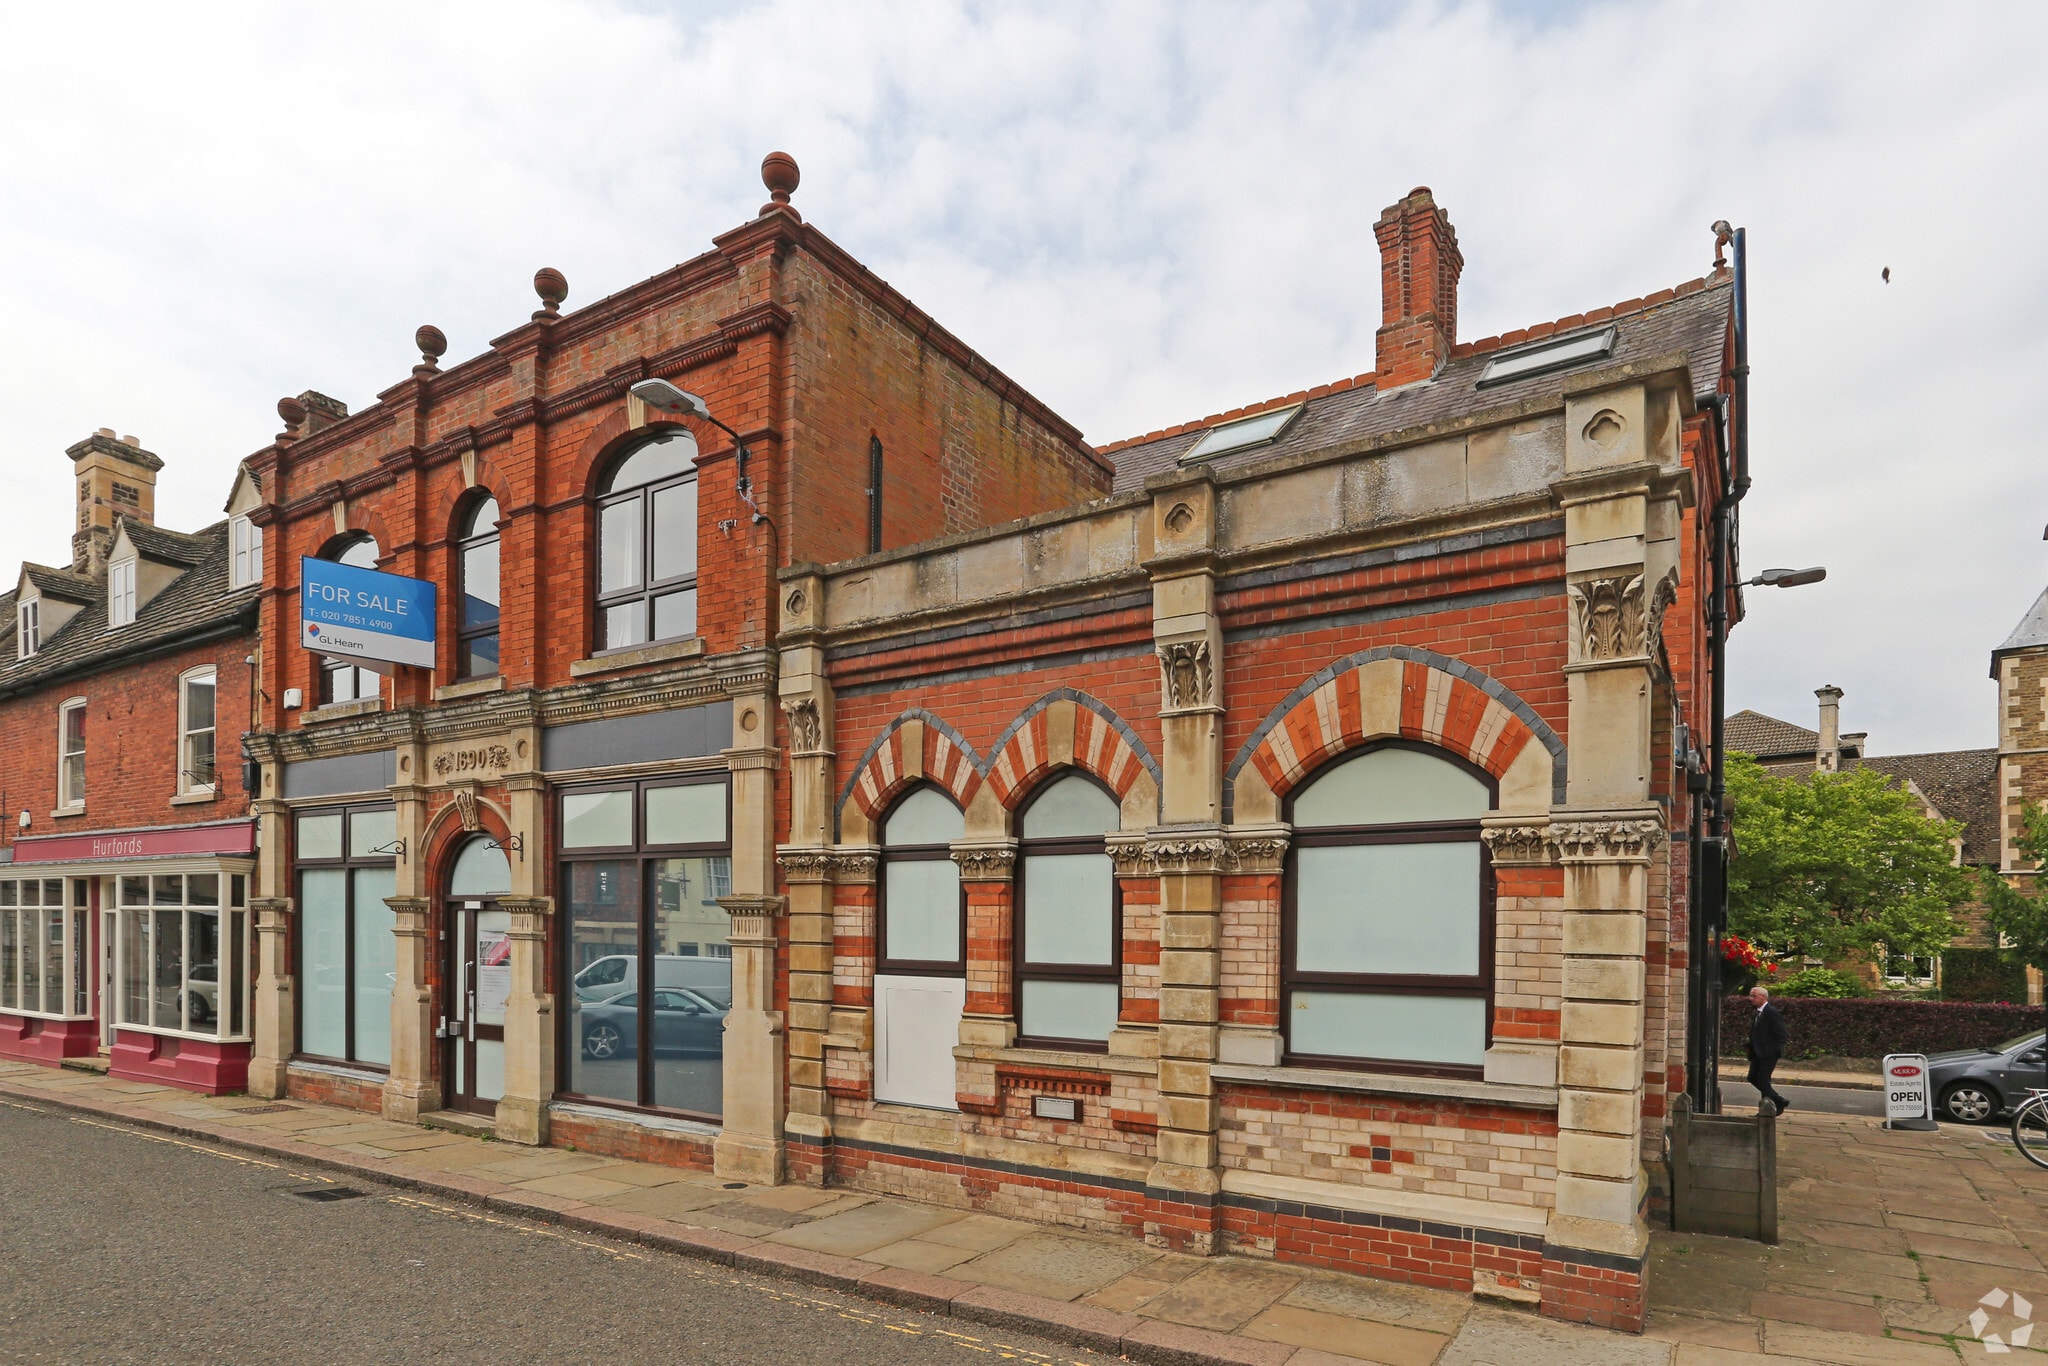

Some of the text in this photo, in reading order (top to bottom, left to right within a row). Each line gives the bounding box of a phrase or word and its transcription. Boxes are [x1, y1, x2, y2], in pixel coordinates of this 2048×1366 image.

[308, 582, 408, 615] FOR SALE
[309, 608, 393, 631] T: 020 7851 4900
[319, 635, 364, 650] GL Hearn
[456, 749, 487, 771] 1890
[93, 837, 142, 856] Hurfords
[1890, 1091, 1922, 1102] OPEN
